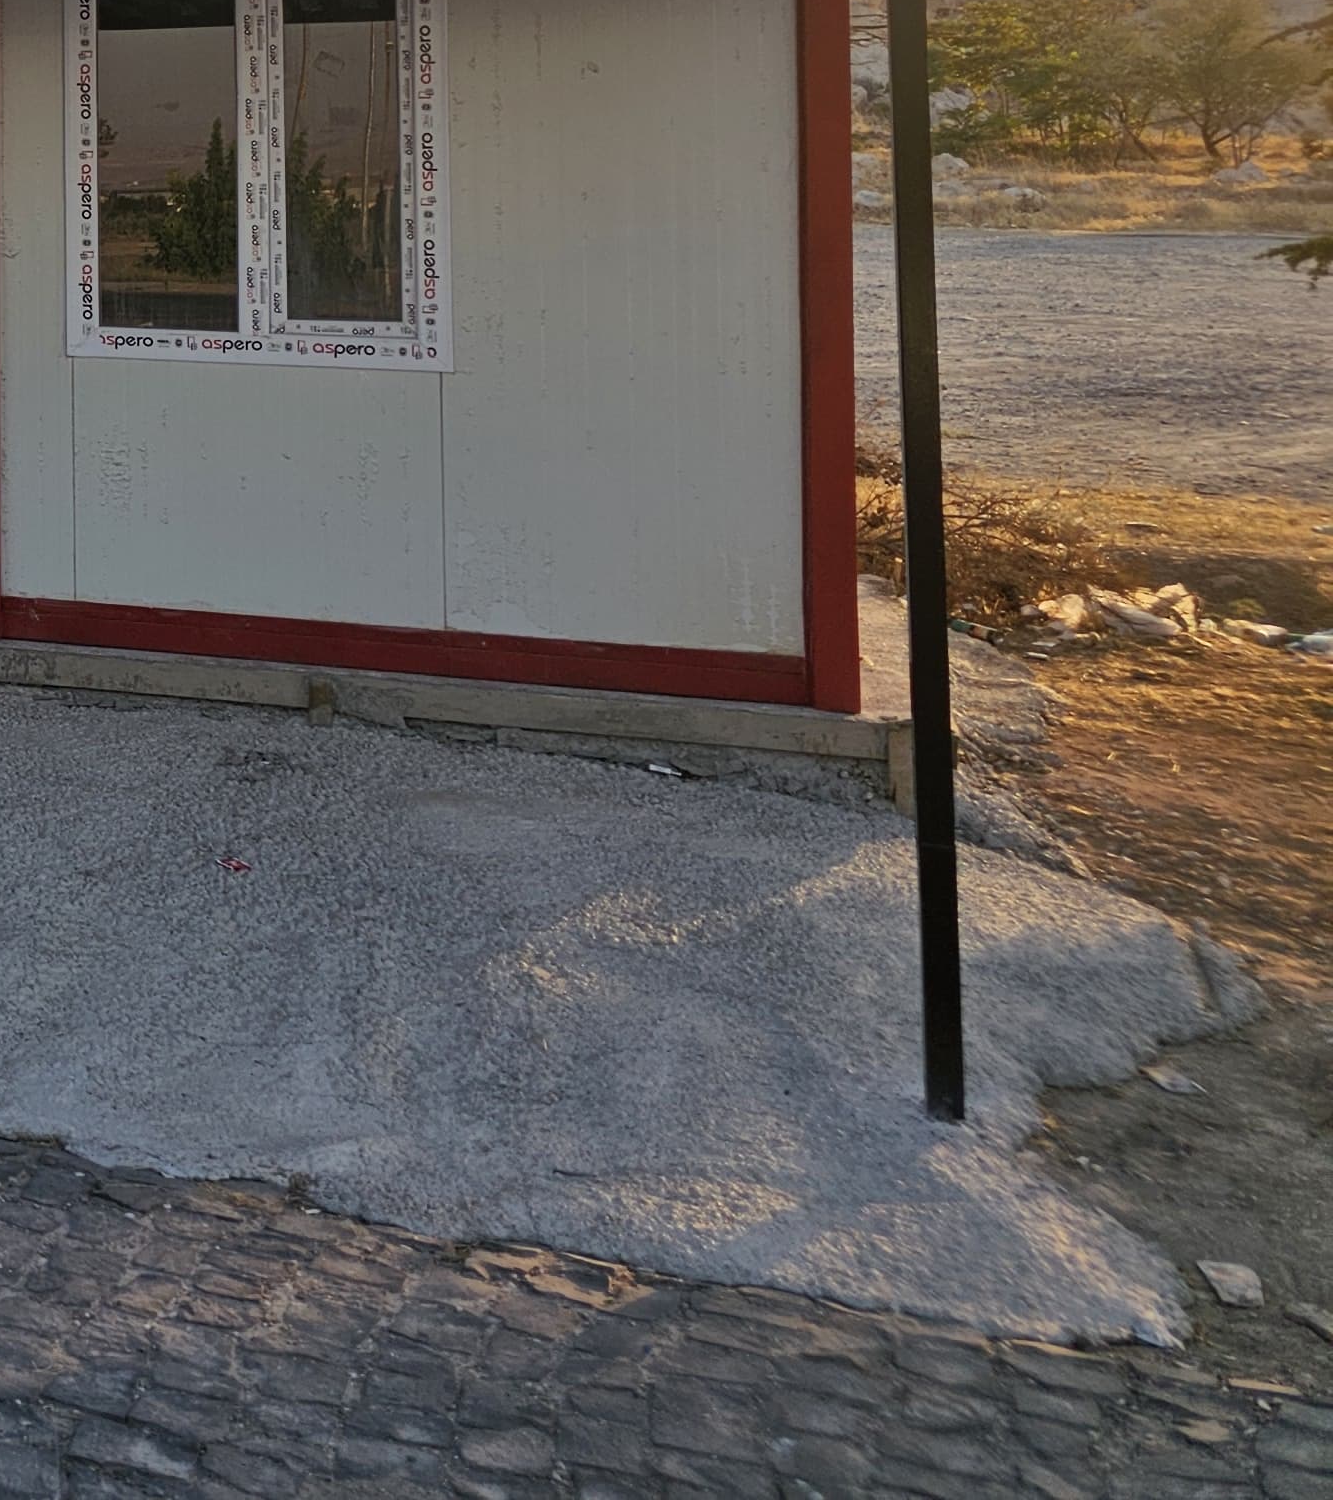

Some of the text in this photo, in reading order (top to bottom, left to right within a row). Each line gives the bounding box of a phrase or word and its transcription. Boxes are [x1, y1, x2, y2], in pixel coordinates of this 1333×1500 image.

[77, 64, 91, 119] aspero
[420, 25, 440, 299] aspero aspero aspero
[77, 164, 92, 220] aspero
[79, 265, 93, 320] aspero
[202, 338, 263, 354] aspero
[312, 342, 376, 358] aspero
